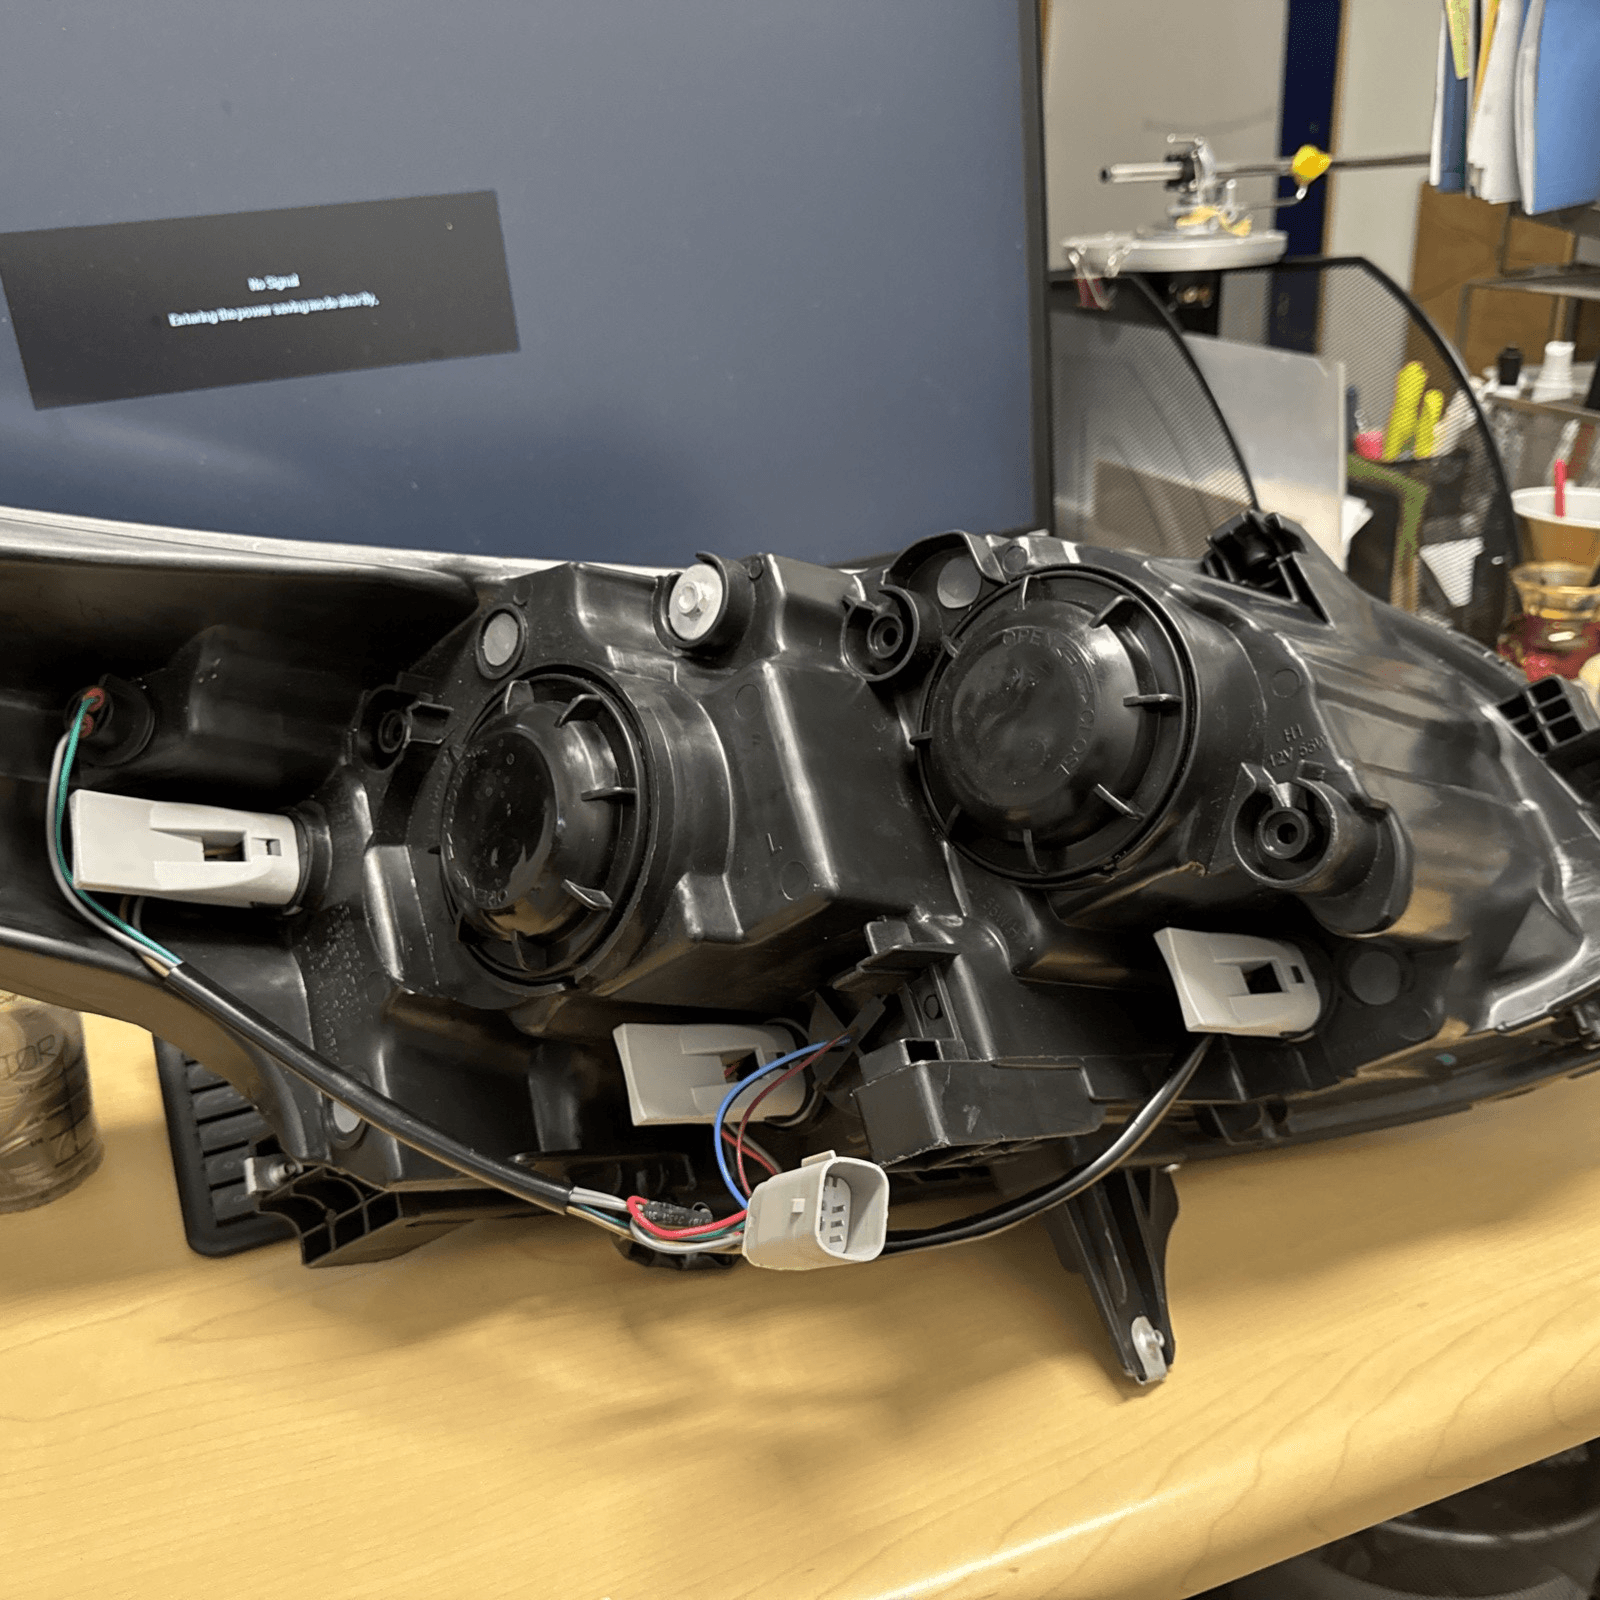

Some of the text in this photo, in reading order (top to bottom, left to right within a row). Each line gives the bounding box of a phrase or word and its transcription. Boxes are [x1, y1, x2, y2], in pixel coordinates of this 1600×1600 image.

[247, 272, 299, 292] No Signal
[167, 290, 380, 327] Entering the power saving mode shortly.
[1283, 723, 1304, 743] H1
[1269, 746, 1294, 767] 12V
